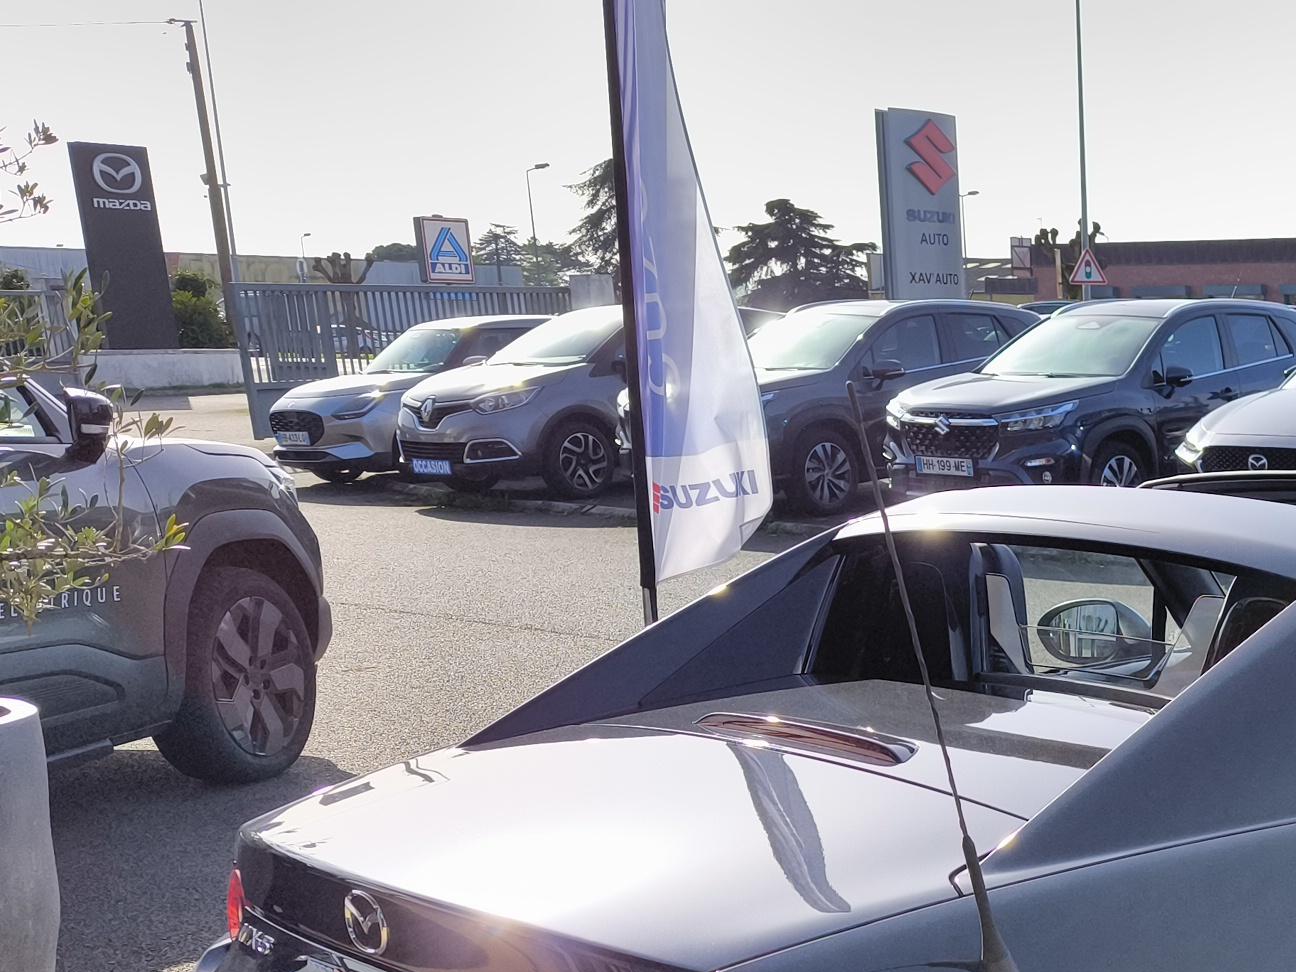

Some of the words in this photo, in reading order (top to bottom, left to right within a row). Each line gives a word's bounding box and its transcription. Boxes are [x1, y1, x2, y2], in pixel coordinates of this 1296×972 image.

[906, 208, 956, 224] SUZUKI
[920, 233, 949, 246] AUTO
[434, 263, 466, 274] ALDI
[412, 459, 451, 473] OCCASION
[658, 469, 759, 511] SUZUKI
